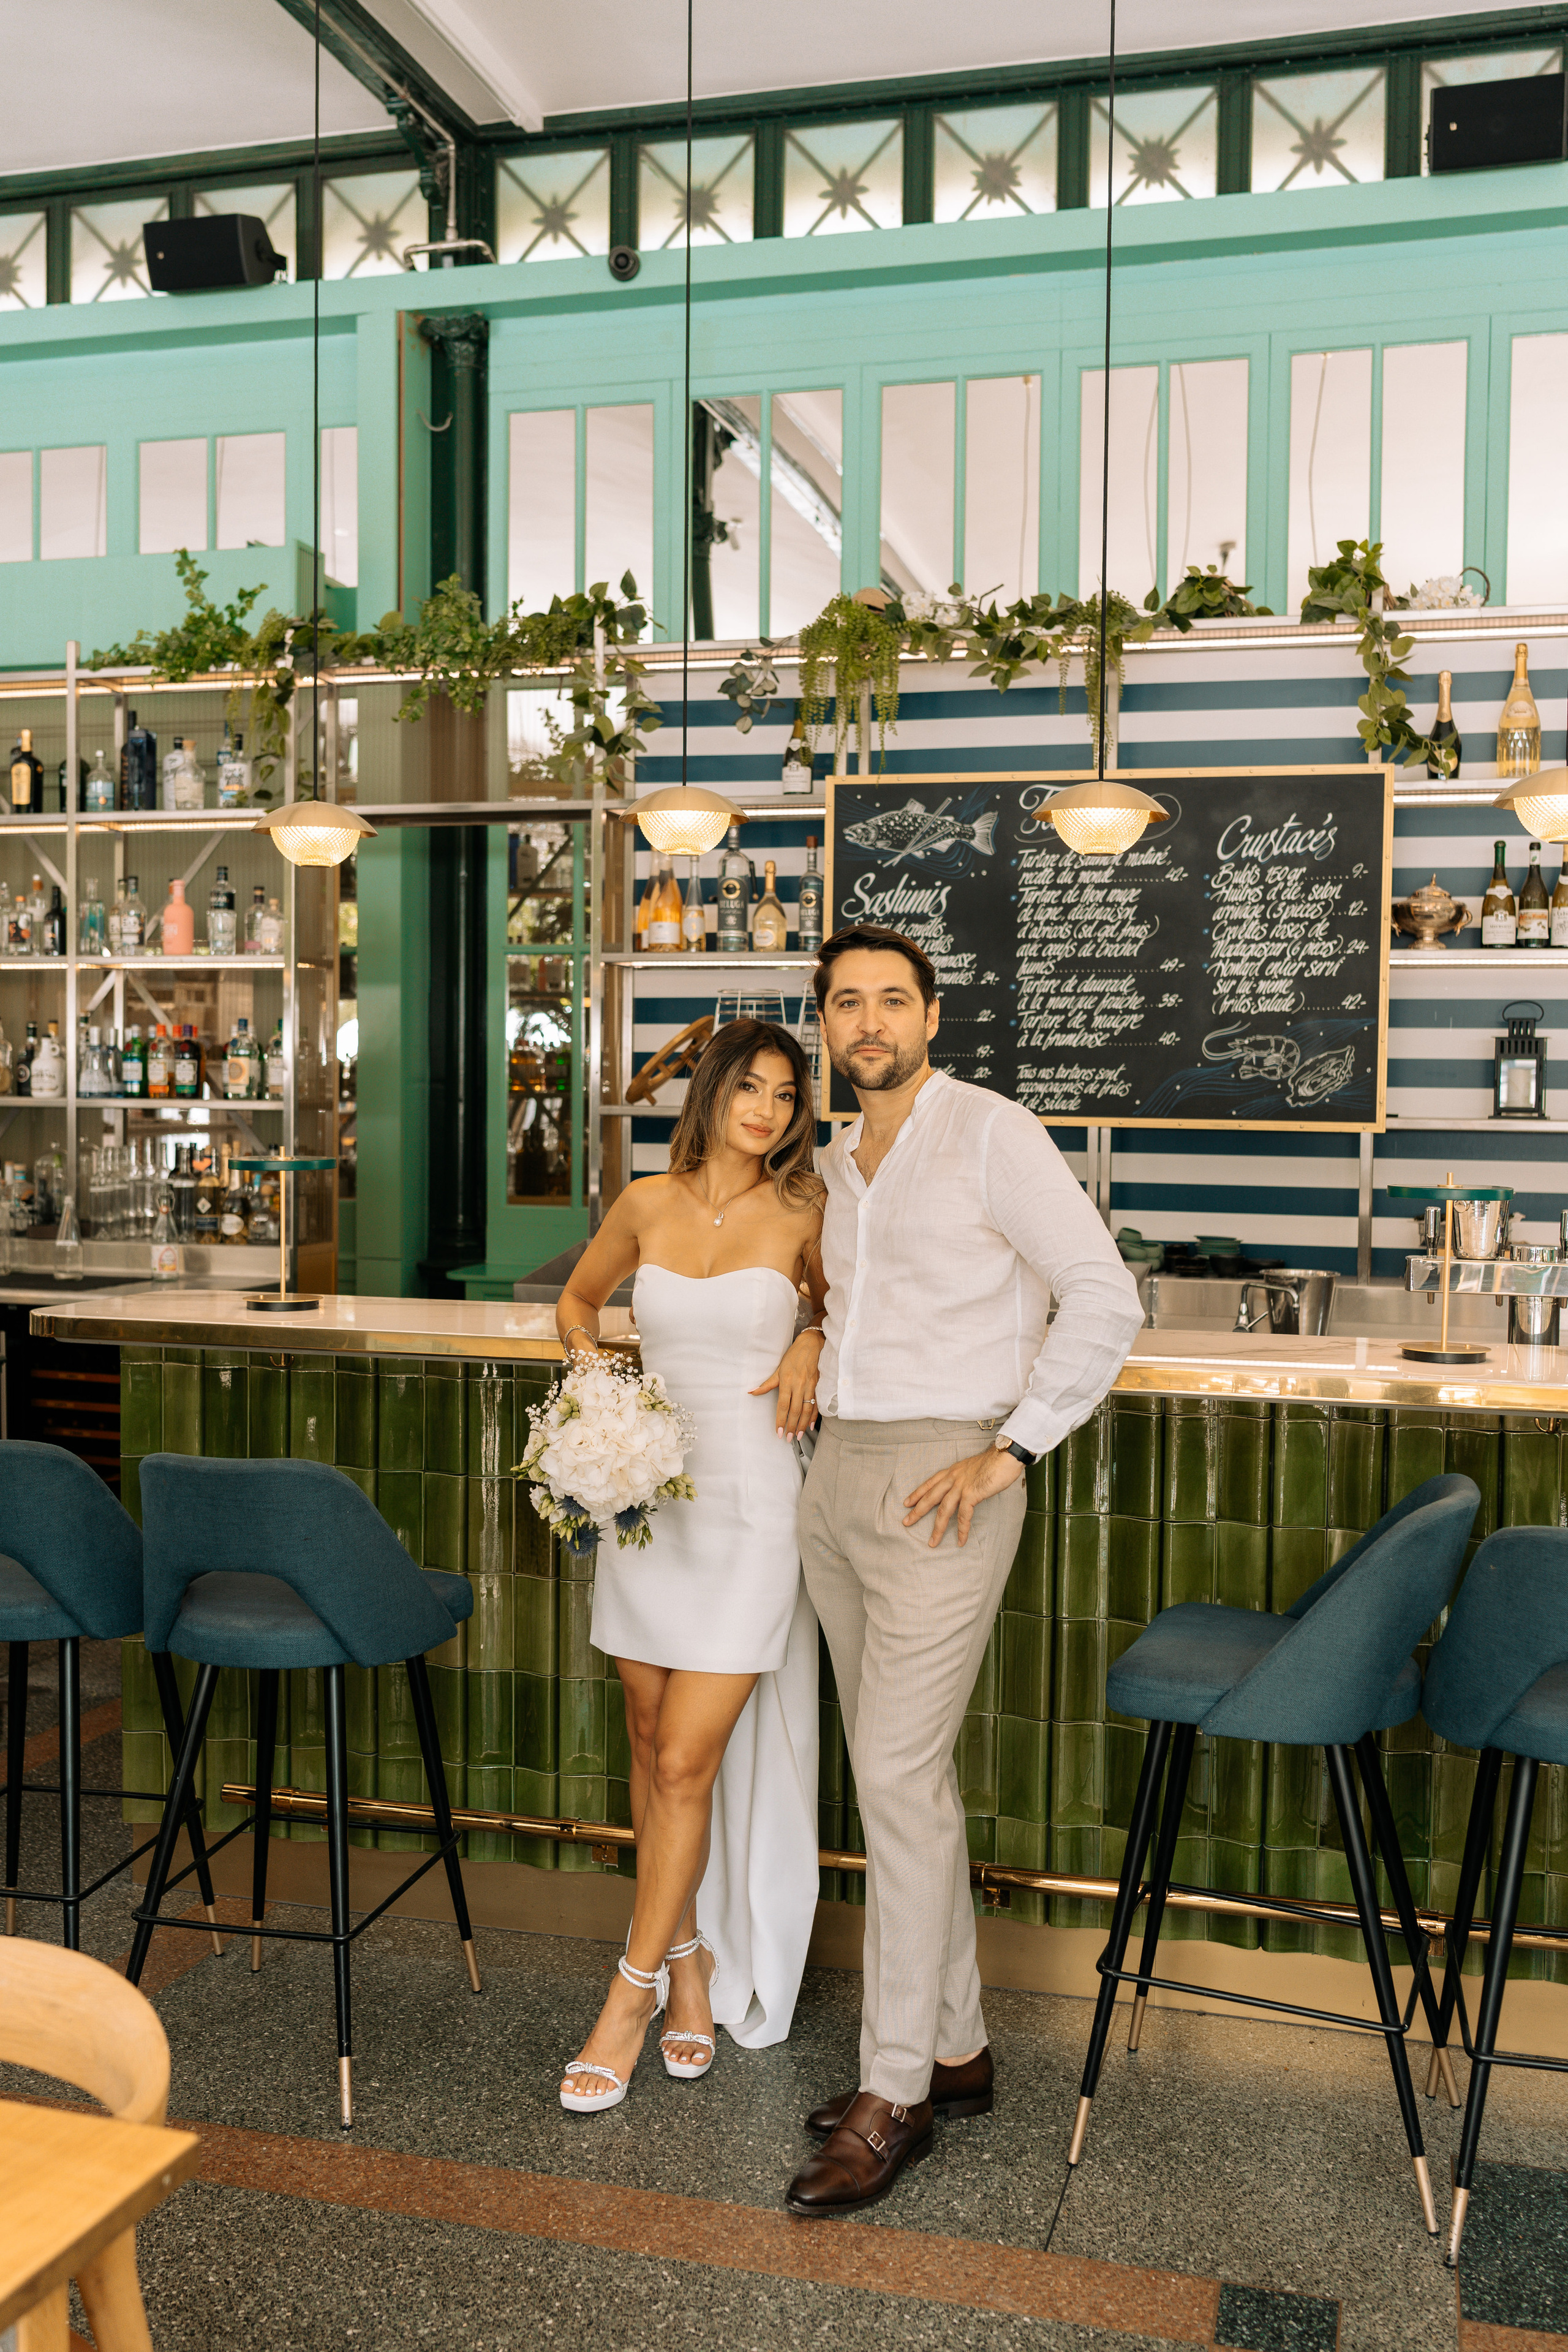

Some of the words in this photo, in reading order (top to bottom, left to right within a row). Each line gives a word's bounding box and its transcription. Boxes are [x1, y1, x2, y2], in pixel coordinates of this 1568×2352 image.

[1217, 813, 1338, 862] Crustacés
[1018, 848, 1060, 871] Tartare
[1059, 851, 1074, 867] de
[1019, 867, 1055, 886] recette
[1057, 867, 1074, 884] du
[1077, 867, 1115, 884] monde
[1212, 863, 1261, 888] Bulots
[842, 873, 952, 918] Sashimis
[1018, 886, 1062, 908] Tartare
[1062, 884, 1080, 904] de
[1080, 884, 1107, 905] thon
[1107, 889, 1142, 908] rouge
[1308, 881, 1343, 901] selon
[1017, 904, 1034, 922] de
[1034, 904, 1065, 924] ligne,
[1068, 904, 1137, 923] déclinaison
[1213, 902, 1265, 923] arrivage
[1017, 921, 1072, 939] d'abricots
[1213, 921, 1268, 940] Crevettes
[1270, 922, 1308, 939] roses
[1308, 918, 1330, 937] de
[1017, 940, 1042, 957] avec
[1078, 940, 1096, 957] de
[1096, 939, 1145, 958] brochet
[1211, 940, 1288, 960] Madagascar
[1017, 957, 1056, 978] fumés
[1207, 959, 1267, 977] Homard
[1265, 959, 1306, 976] entier
[1305, 957, 1346, 977] servi
[1018, 976, 1061, 997] Tartare
[1061, 974, 1078, 993] de
[1077, 974, 1136, 993] daurade
[1213, 980, 1237, 995] sur
[1237, 977, 1294, 995] lui-même
[1018, 993, 1029, 1010] à
[1030, 993, 1044, 1010] la
[1046, 996, 1098, 1017] mangue
[1018, 1011, 1065, 1031] Tartare
[1068, 1011, 1087, 1029] de
[1091, 1011, 1144, 1036] maigre
[1017, 1030, 1029, 1047] à
[1030, 1030, 1044, 1047] la
[1042, 1028, 1110, 1050] framboise
[1017, 1065, 1037, 1080] Tous
[1038, 1067, 1055, 1079] nos
[1055, 1063, 1096, 1080] tartares
[1096, 1063, 1126, 1081] sont
[1017, 1080, 1084, 1099] accompagnés
[1084, 1080, 1100, 1095] de
[1098, 1080, 1132, 1098] frites
[1027, 1095, 1040, 1109] de
[1038, 1095, 1081, 1112] salade
